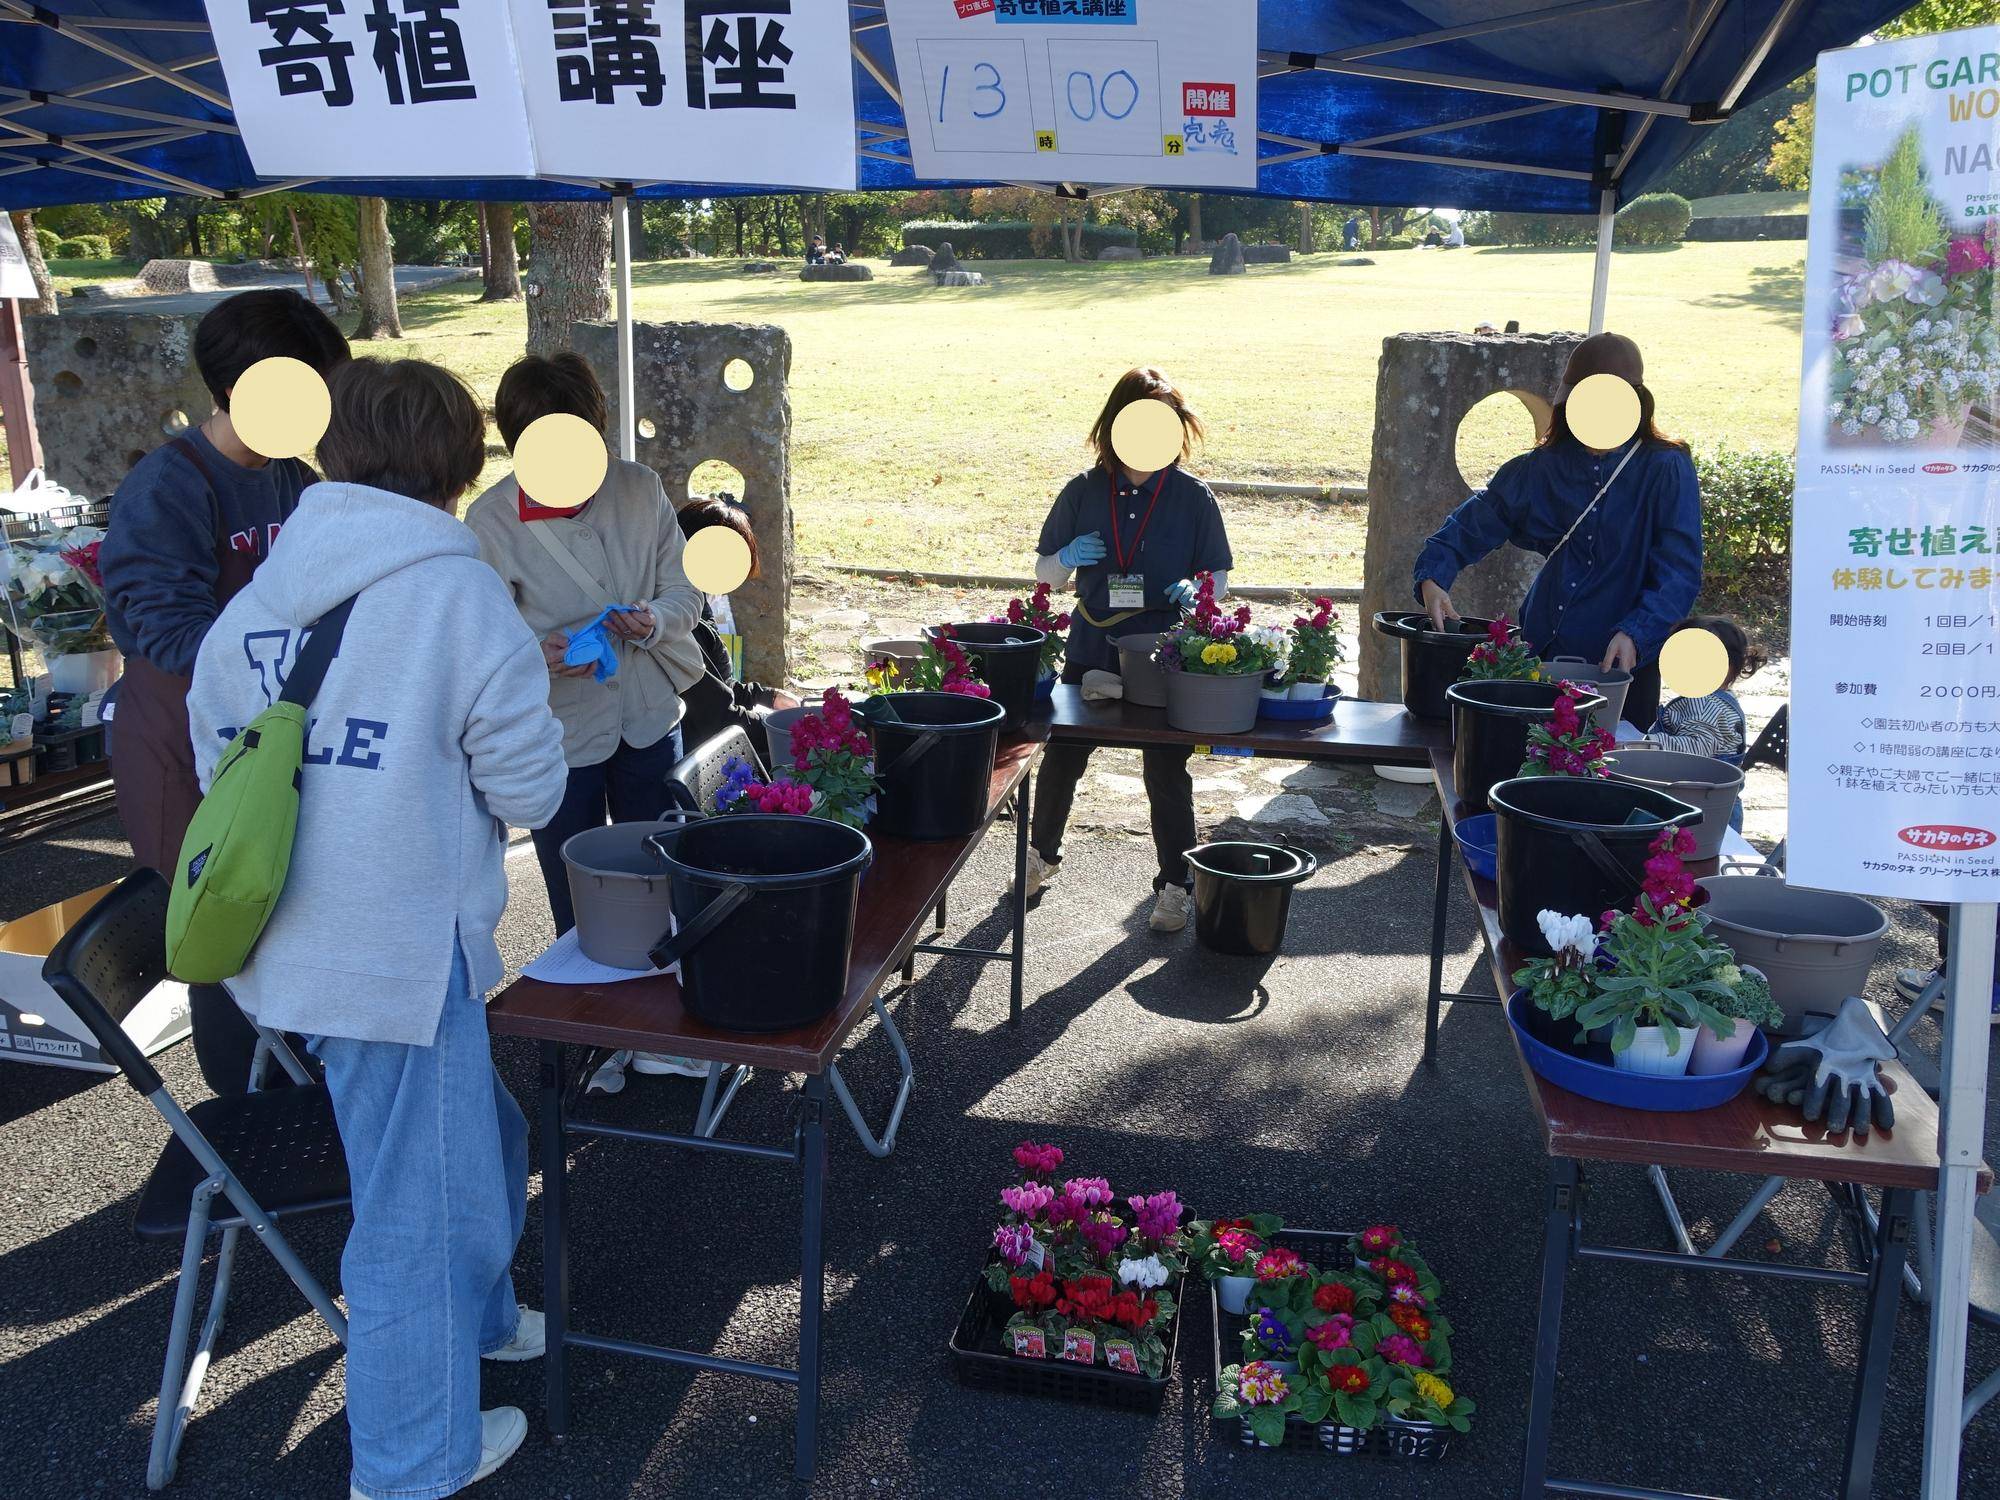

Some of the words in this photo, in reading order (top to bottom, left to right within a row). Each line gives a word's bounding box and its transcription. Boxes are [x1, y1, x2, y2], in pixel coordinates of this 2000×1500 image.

[940, 63, 1006, 123] 13
[1846, 64, 1918, 103] POT
[1067, 69, 1140, 122] 00
[1185, 89, 1231, 111] 開催
[1948, 88, 2000, 122] WO
[1038, 136, 1054, 150] 時
[1166, 140, 1182, 154] 分
[1944, 143, 2000, 176] NA
[1875, 465, 1885, 475] in
[1887, 464, 1916, 475] Seed
[1848, 525, 2000, 557] 寄せ植え
[1829, 613, 1888, 627] 開始時刻
[1834, 681, 1878, 697] 参加費
[1906, 828, 1989, 847] サカタのタネ
[1954, 855, 1965, 865] in
[1967, 855, 1995, 865] Seed
